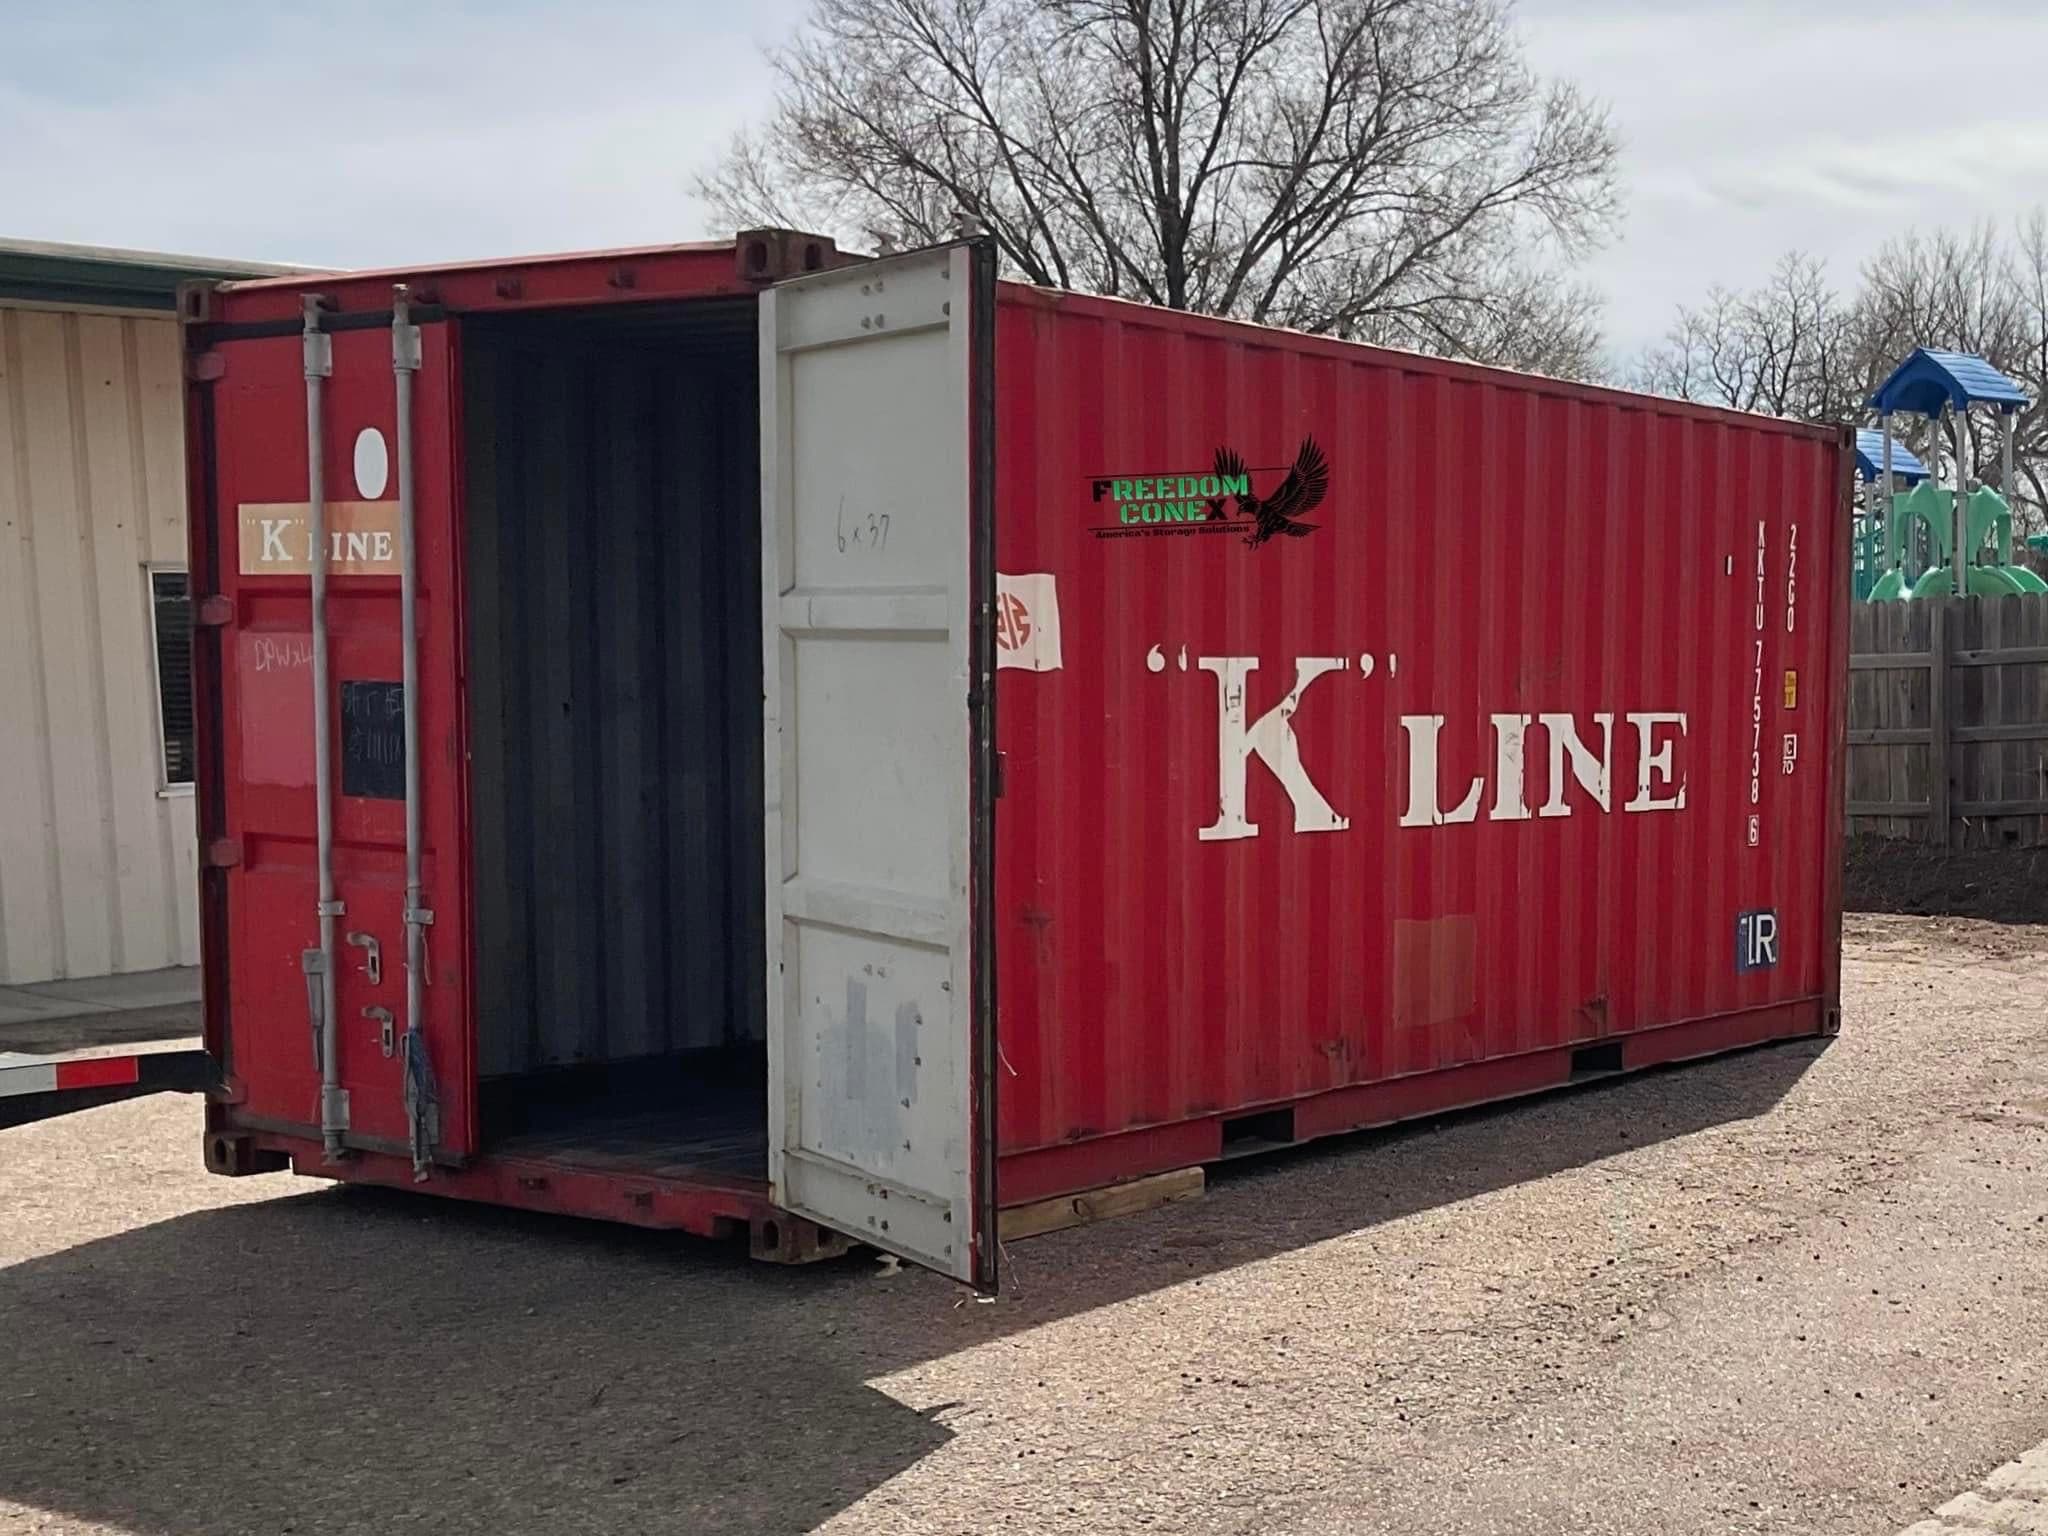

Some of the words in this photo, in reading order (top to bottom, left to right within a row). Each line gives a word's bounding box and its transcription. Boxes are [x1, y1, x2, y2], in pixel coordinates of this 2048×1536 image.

[307, 532, 393, 561] INE
[1401, 711, 1687, 828] LINE
[1751, 640, 1762, 804] 775738
